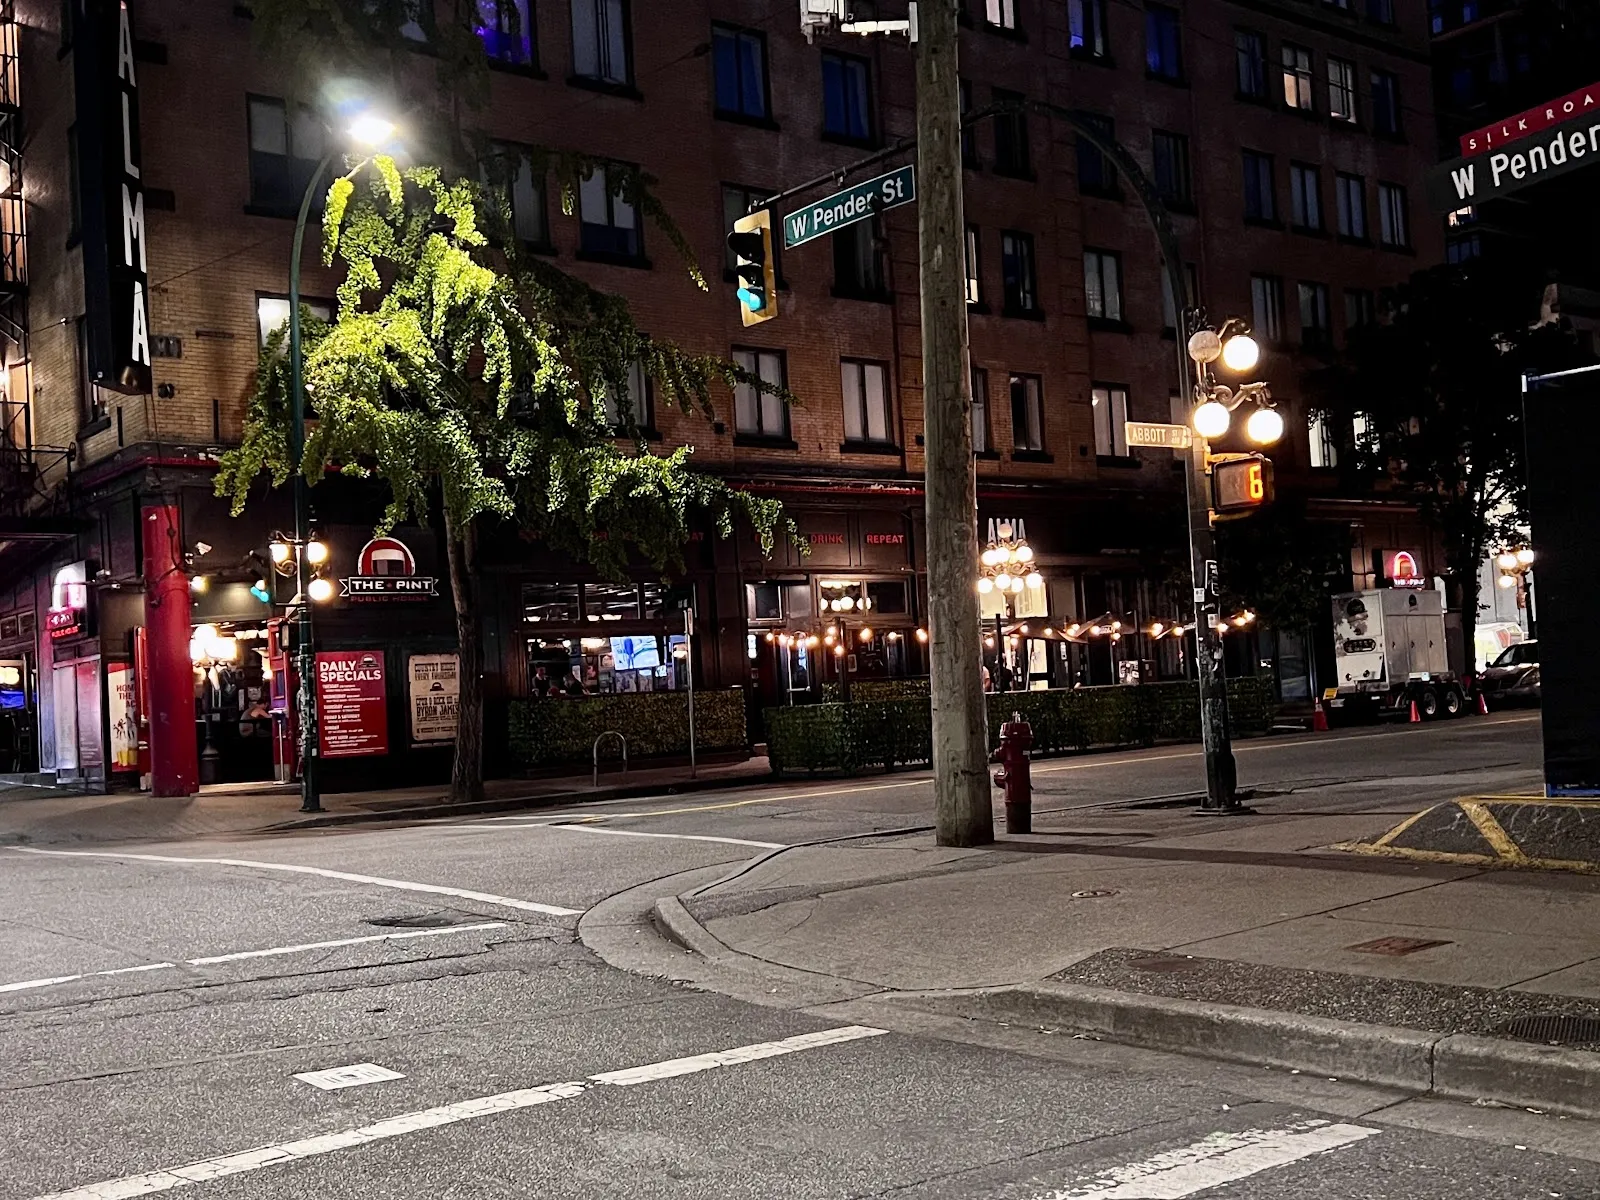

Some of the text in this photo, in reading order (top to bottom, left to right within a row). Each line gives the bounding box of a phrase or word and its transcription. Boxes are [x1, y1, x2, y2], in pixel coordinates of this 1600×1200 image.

[1469, 118, 1527, 150] SILK
[118, 1, 150, 366] ALMA
[1451, 164, 1475, 200] W
[791, 176, 904, 239] W Pender St
[1132, 427, 1166, 443] ABBOTT
[1249, 465, 1264, 499] 6
[810, 534, 844, 544] DRINK
[866, 534, 904, 544] REPEAT
[351, 581, 431, 590] THE PINT
[320, 661, 356, 671] DAILY
[320, 670, 381, 682] SPECIALS
[119, 693, 133, 701] THE
